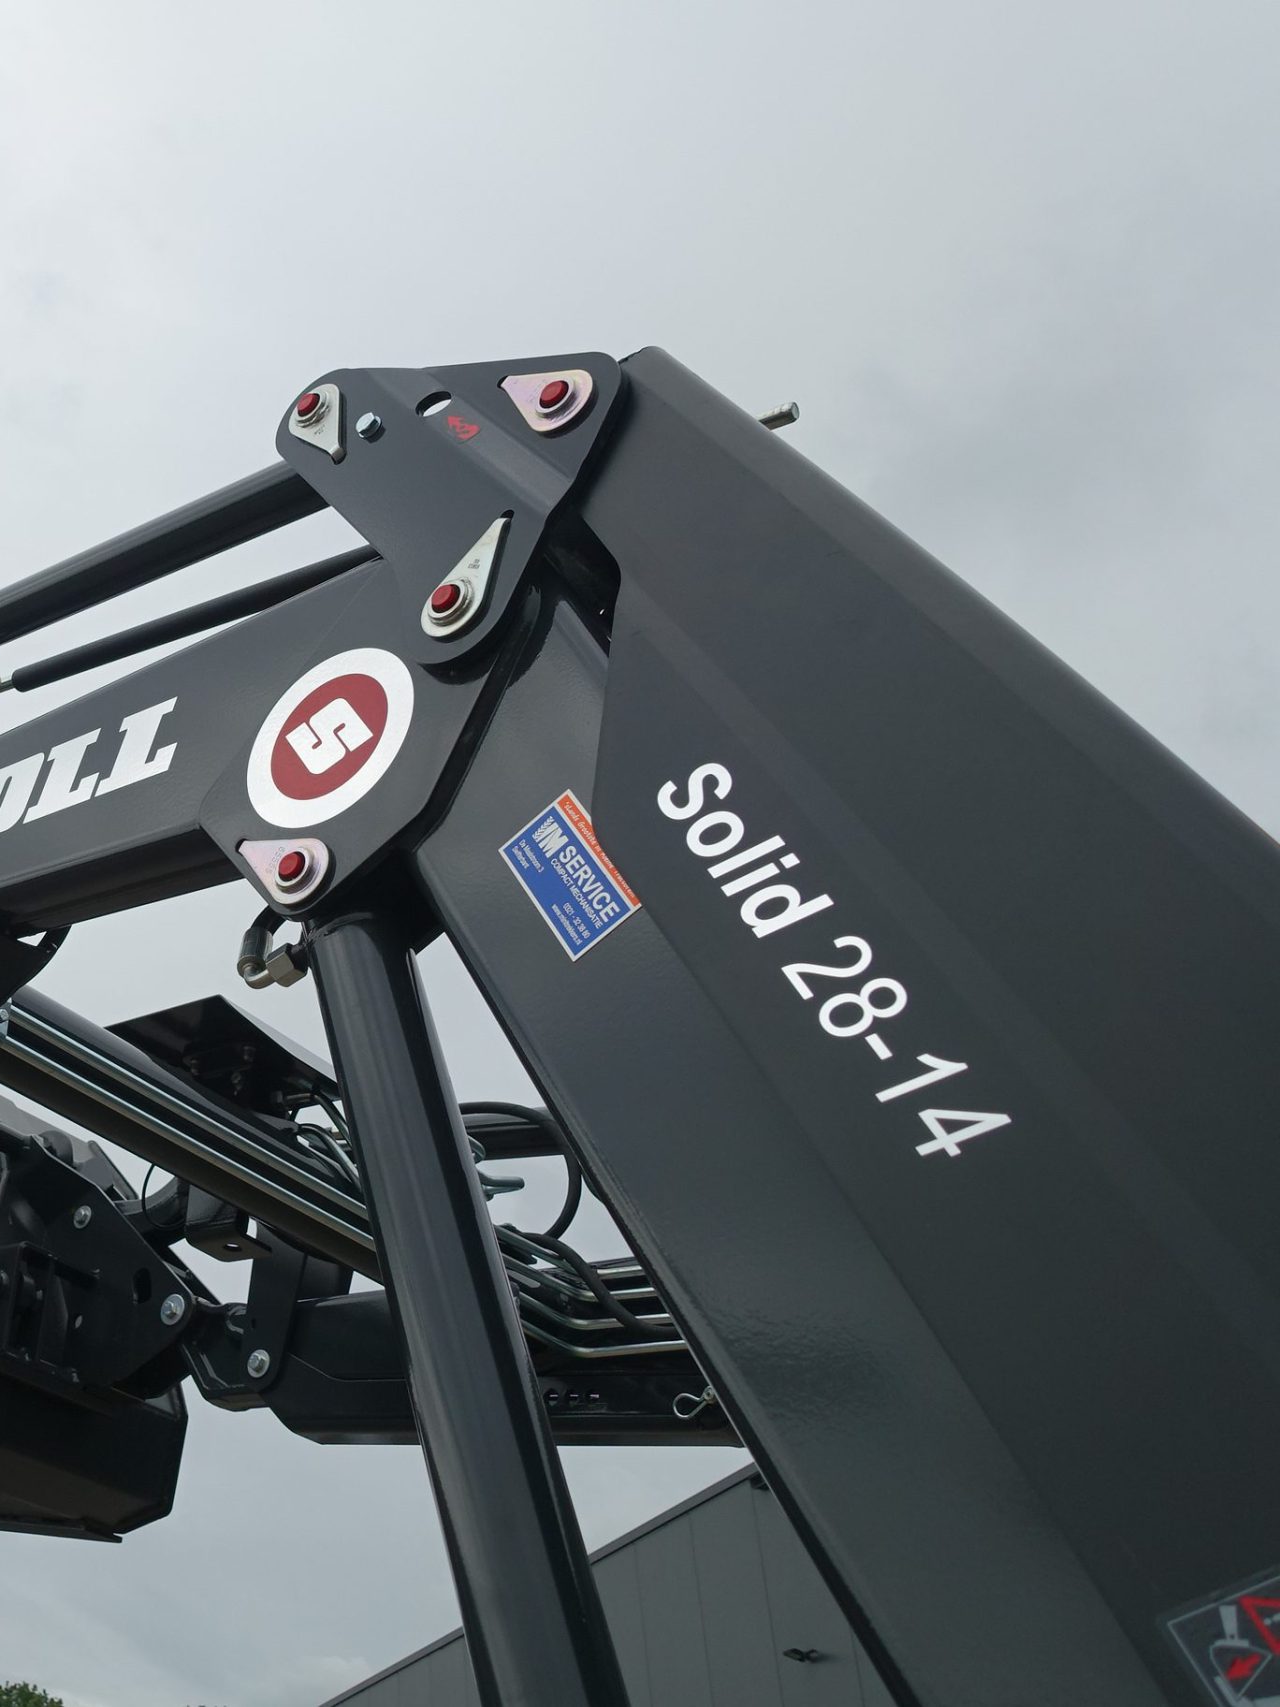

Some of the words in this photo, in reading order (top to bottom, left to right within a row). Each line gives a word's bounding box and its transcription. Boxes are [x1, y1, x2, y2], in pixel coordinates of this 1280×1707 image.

[550, 858, 574, 888] COMPACT
[569, 885, 603, 929] MECHANISATIE
[558, 845, 621, 923] SERVICE
[658, 762, 834, 939] Solid
[781, 935, 1012, 1158] 28-14
